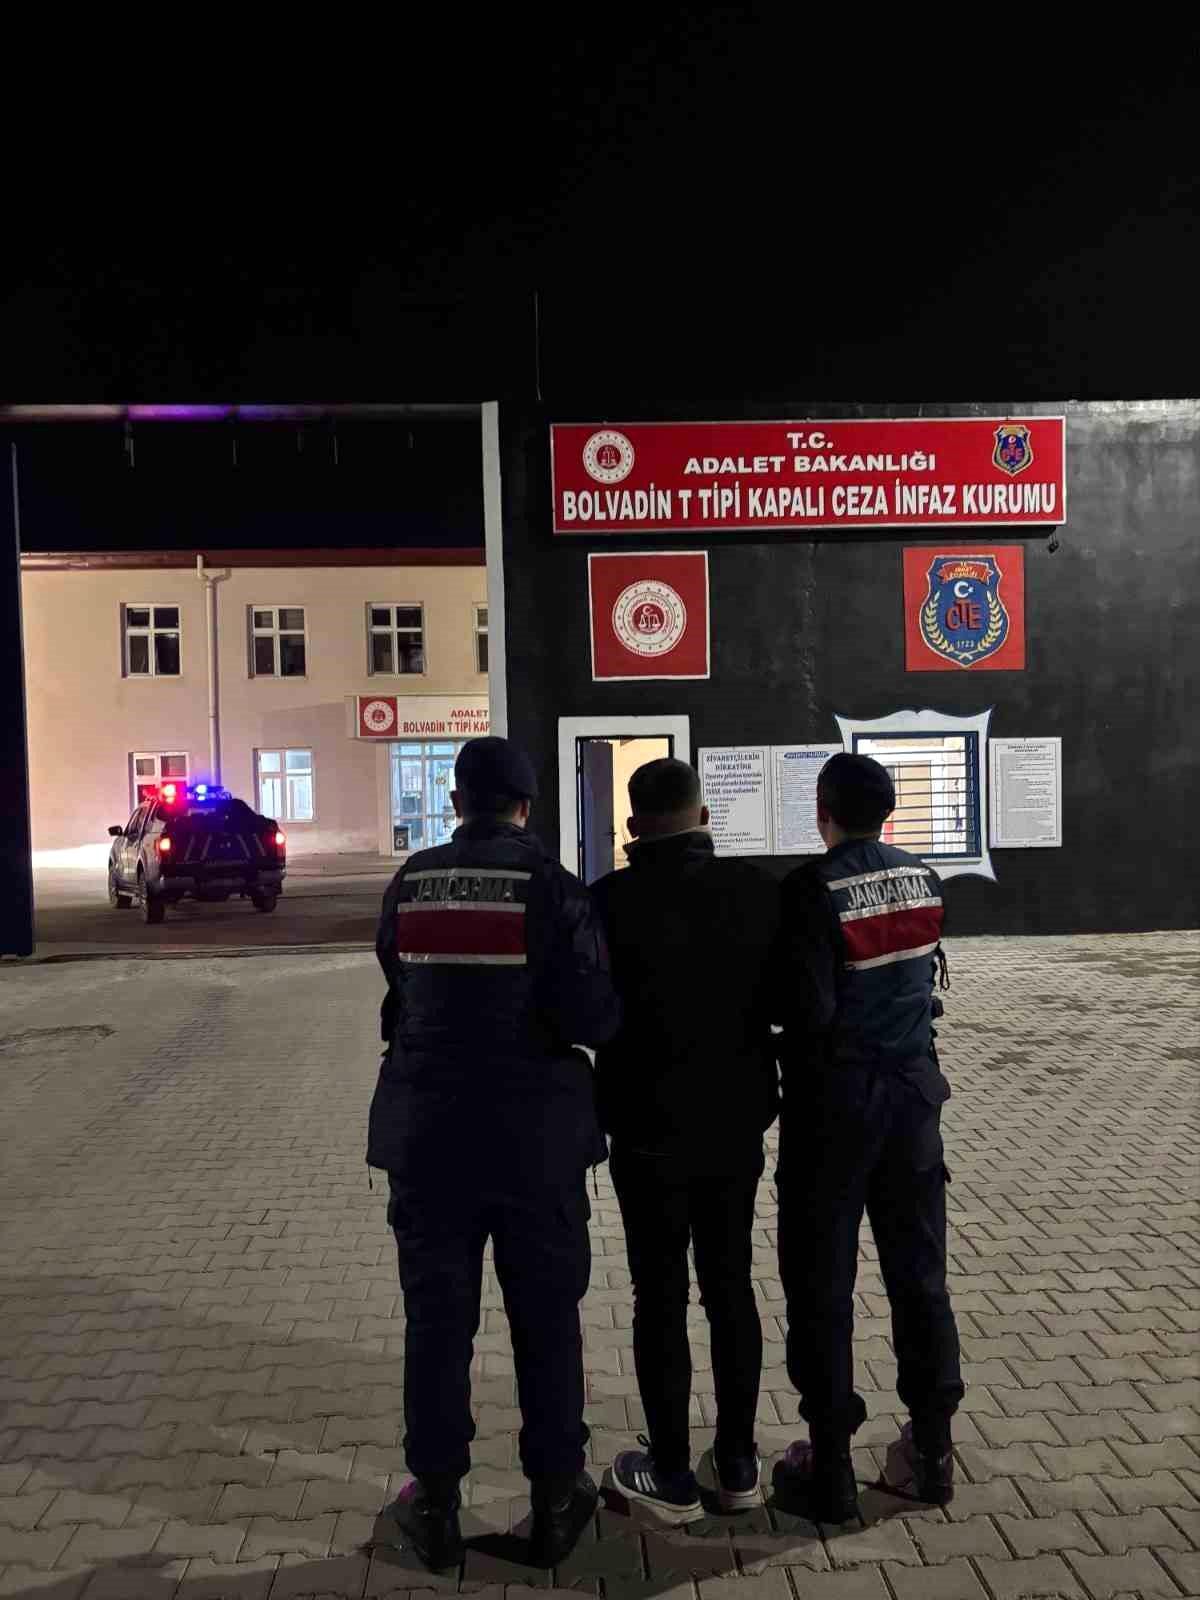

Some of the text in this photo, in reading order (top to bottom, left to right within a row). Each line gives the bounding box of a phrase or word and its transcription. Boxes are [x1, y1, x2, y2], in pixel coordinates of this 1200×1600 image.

[787, 432, 834, 449] T.C.
[683, 450, 936, 474] ADALET BAKANLIĞI
[563, 478, 1056, 521] BOLVADİN T TİPİ KAPALI CEZA İNFAZ KURUMU
[945, 599, 983, 631] CTE
[450, 709, 489, 718] ADALET
[403, 719, 445, 733] BOLVADİN
[447, 721, 454, 733] T
[455, 719, 472, 733] TİPİ
[847, 875, 933, 909] JANDARMA
